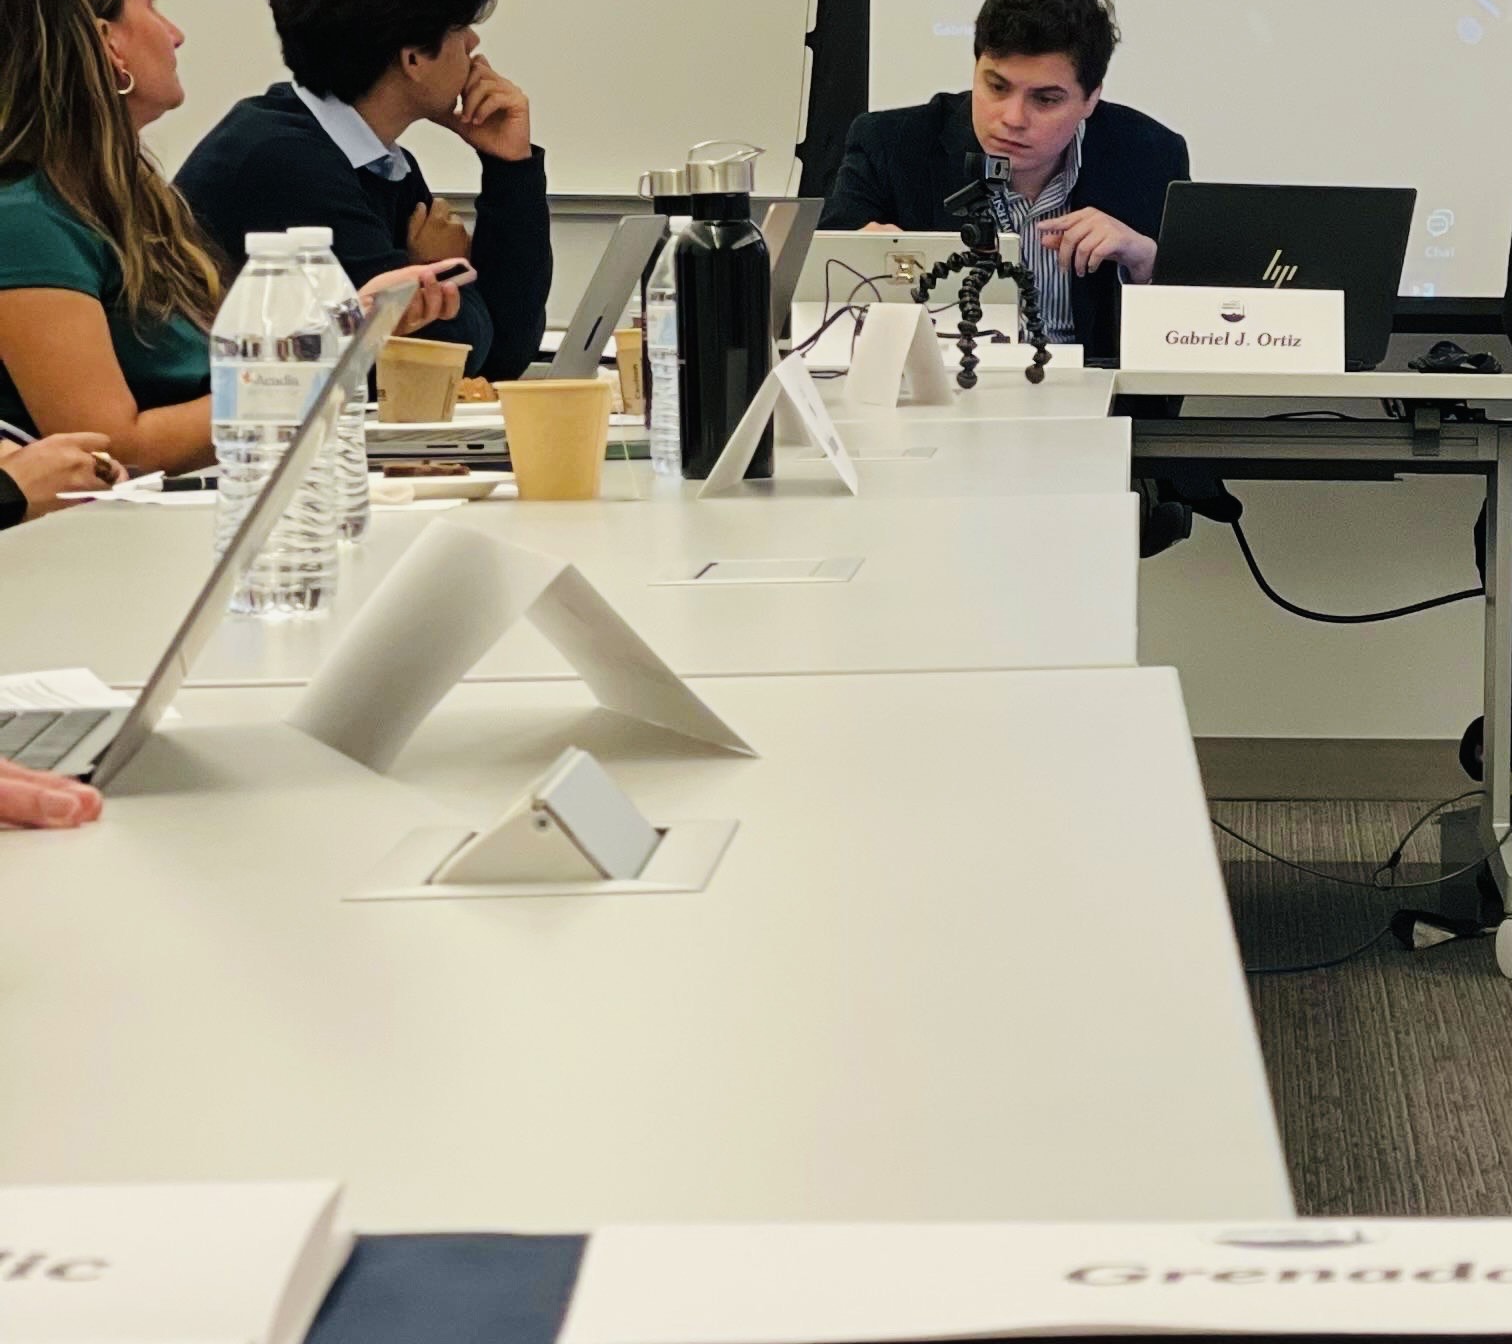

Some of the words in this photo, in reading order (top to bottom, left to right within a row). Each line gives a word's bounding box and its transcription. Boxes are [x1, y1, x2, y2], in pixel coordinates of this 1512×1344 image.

[1262, 249, 1298, 289] hp
[1165, 330, 1230, 347] Gabriel
[1234, 332, 1251, 347] J.
[1257, 332, 1302, 348] Ortiz
